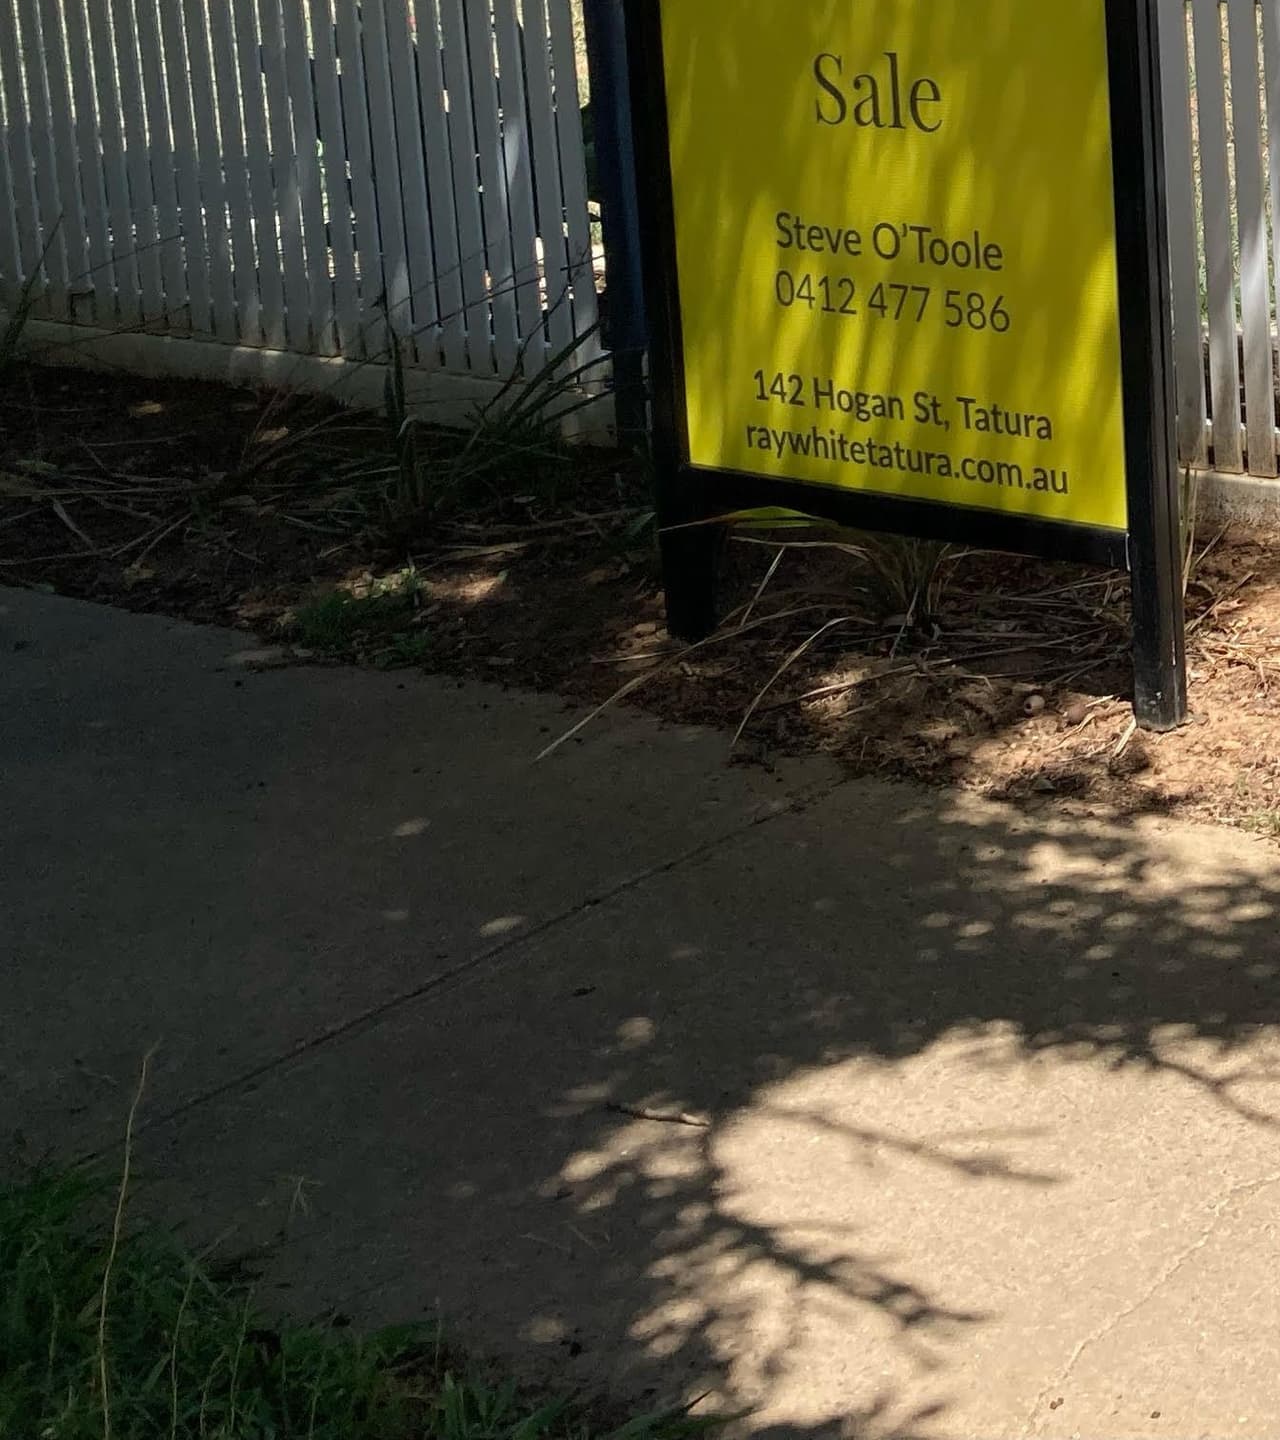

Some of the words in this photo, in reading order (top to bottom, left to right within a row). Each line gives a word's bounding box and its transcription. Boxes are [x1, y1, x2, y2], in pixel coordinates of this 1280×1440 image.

[812, 52, 943, 133] Sale
[774, 211, 862, 257] Steve
[872, 222, 1004, 272] O'Toole
[774, 270, 858, 316] 0412
[868, 283, 931, 323] 477
[943, 290, 1011, 333] 586
[753, 369, 805, 408] 142
[813, 377, 904, 423] Hogan
[913, 391, 951, 433] St,
[956, 397, 1053, 441] Tatura
[746, 422, 1069, 495] raywhitetatura.com.au
